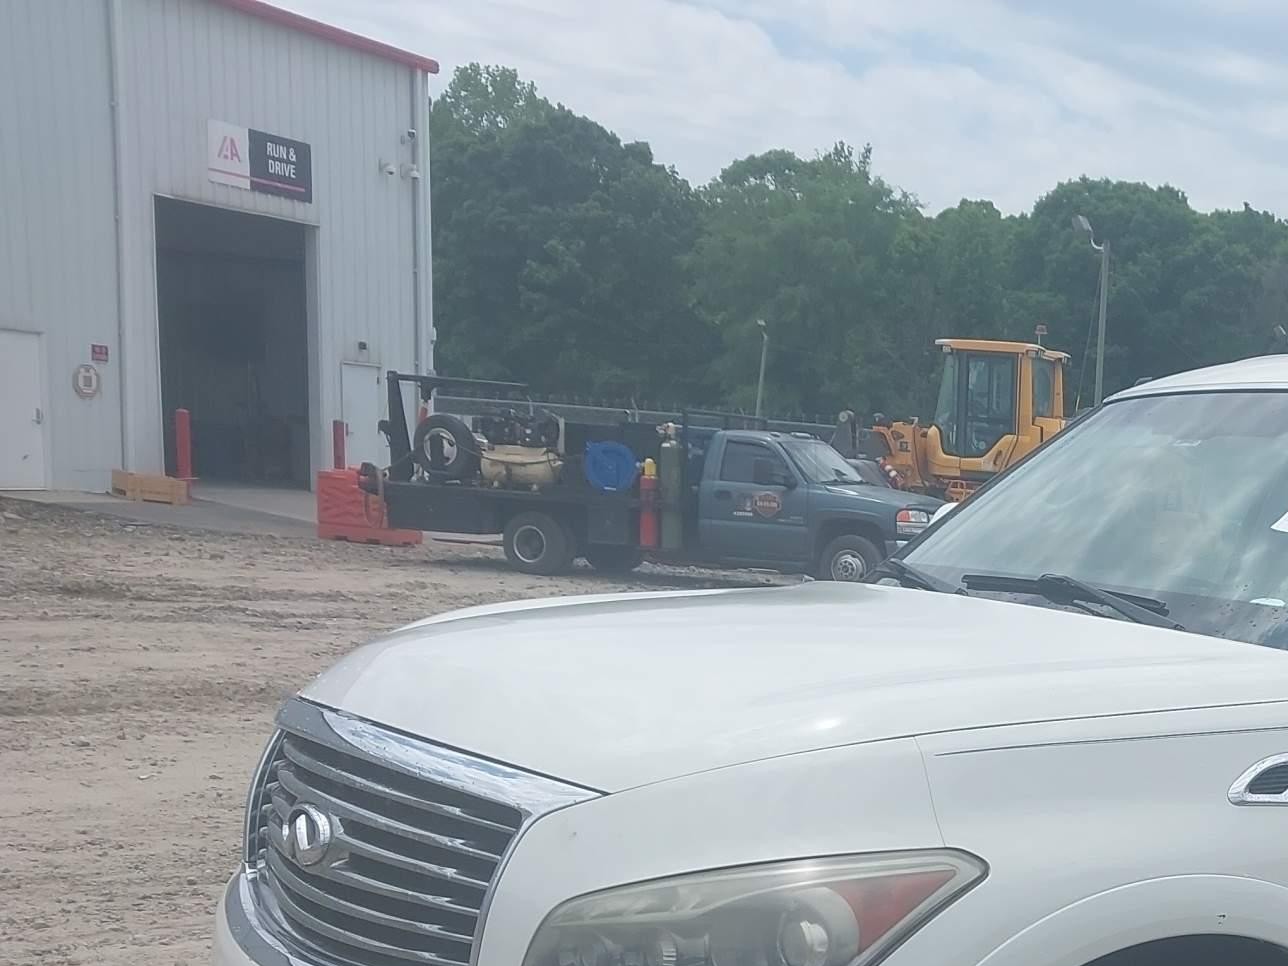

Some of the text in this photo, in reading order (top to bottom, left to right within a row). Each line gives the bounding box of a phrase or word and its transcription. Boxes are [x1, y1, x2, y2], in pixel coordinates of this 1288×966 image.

[266, 142, 296, 161] RUN &
[268, 159, 296, 178] DRIVE
